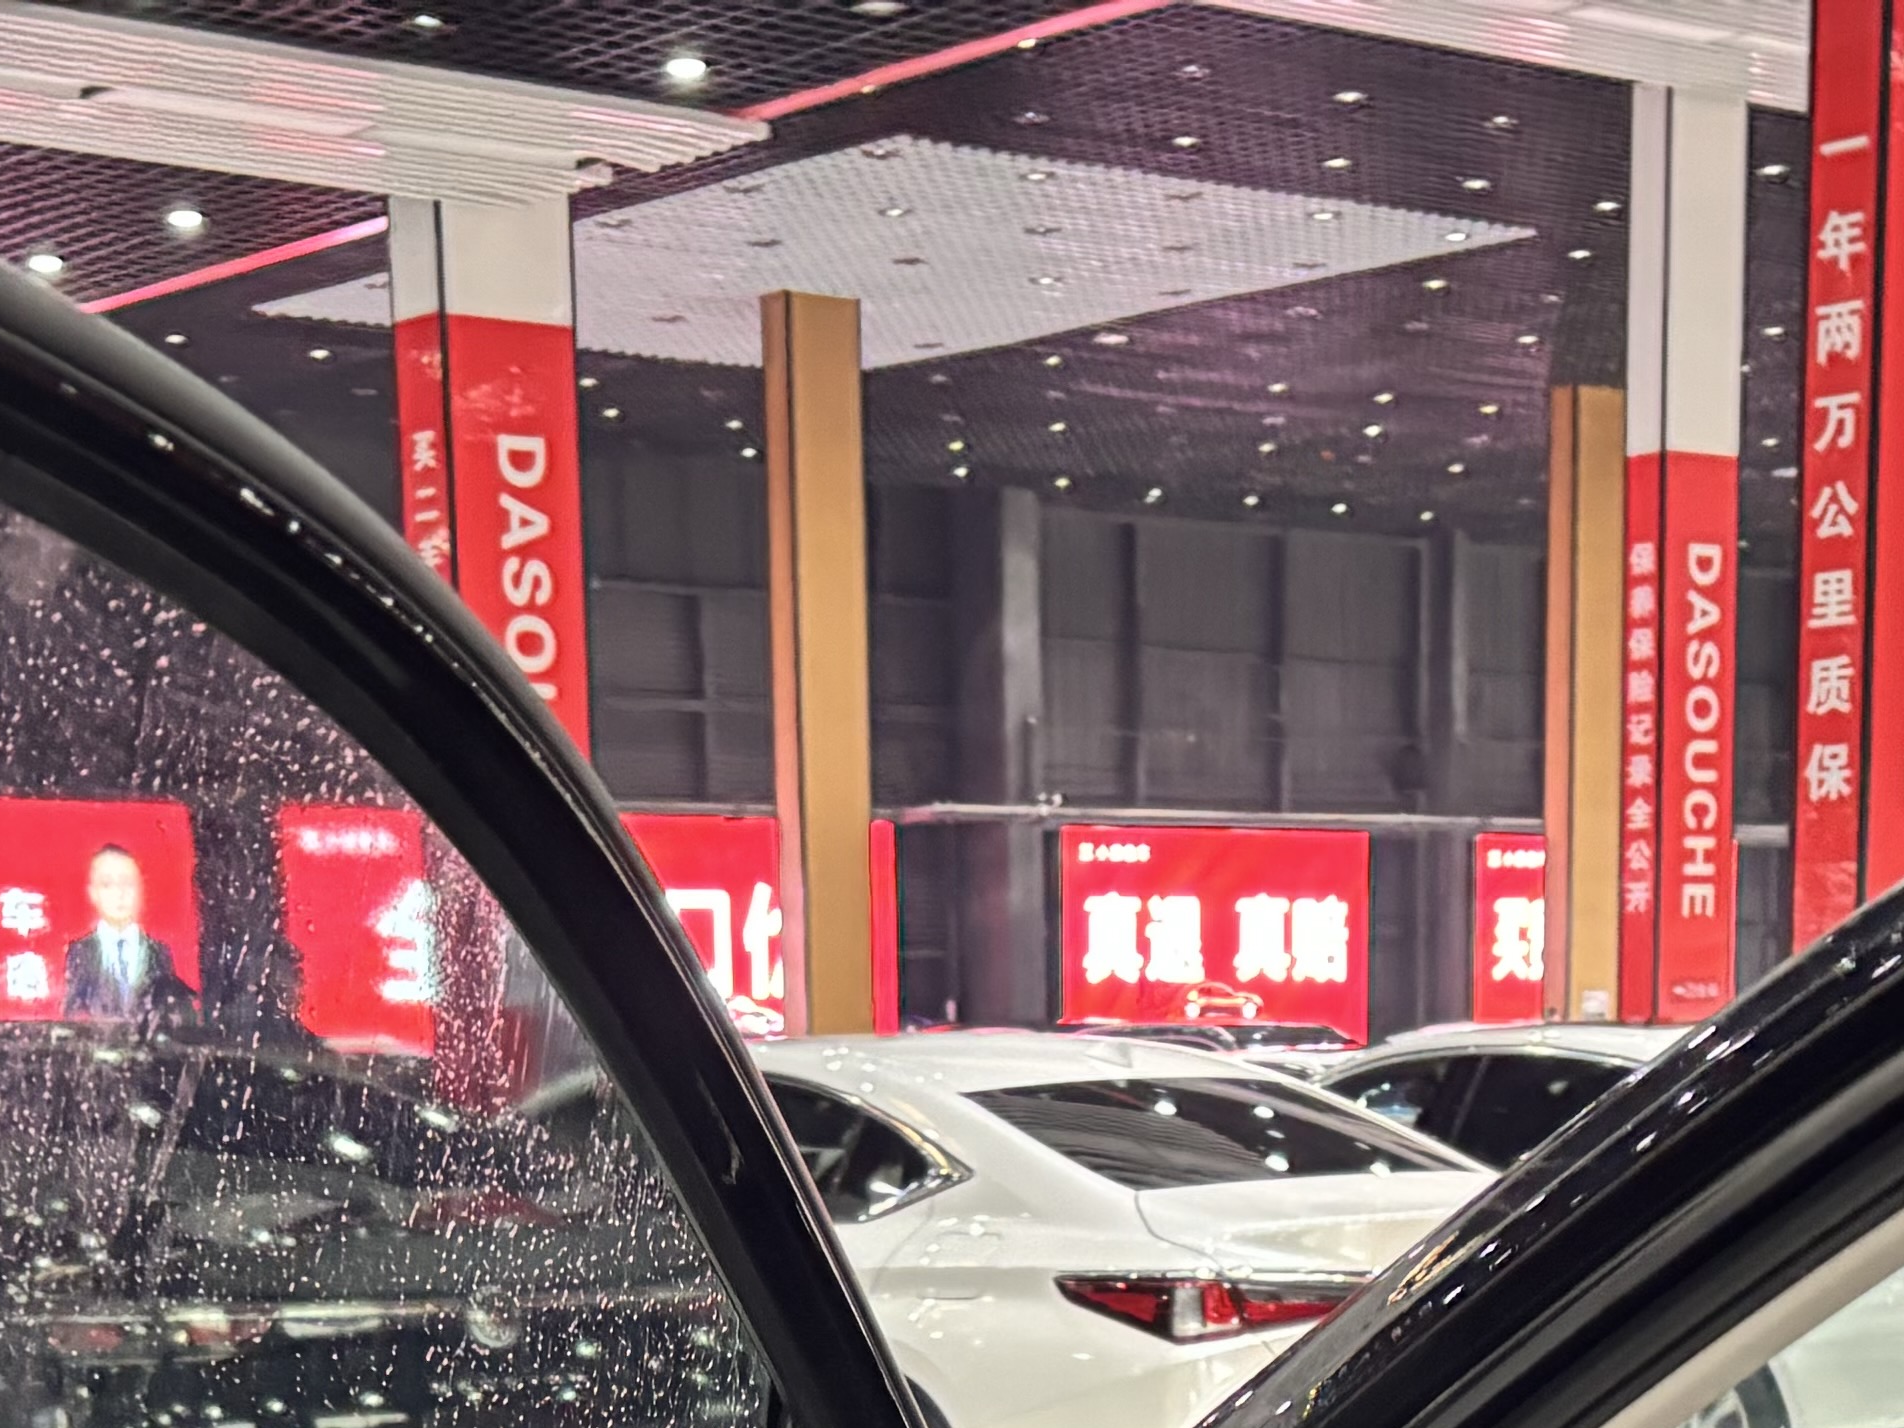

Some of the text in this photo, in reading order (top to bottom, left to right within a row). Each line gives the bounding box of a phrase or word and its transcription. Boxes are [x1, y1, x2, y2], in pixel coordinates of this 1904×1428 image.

[496, 433, 558, 702] DASO
[1804, 134, 1870, 804] 一年两万公里质保
[1625, 541, 1657, 914] 保养保险记录全公开
[1680, 541, 1724, 919] DASOUCHE
